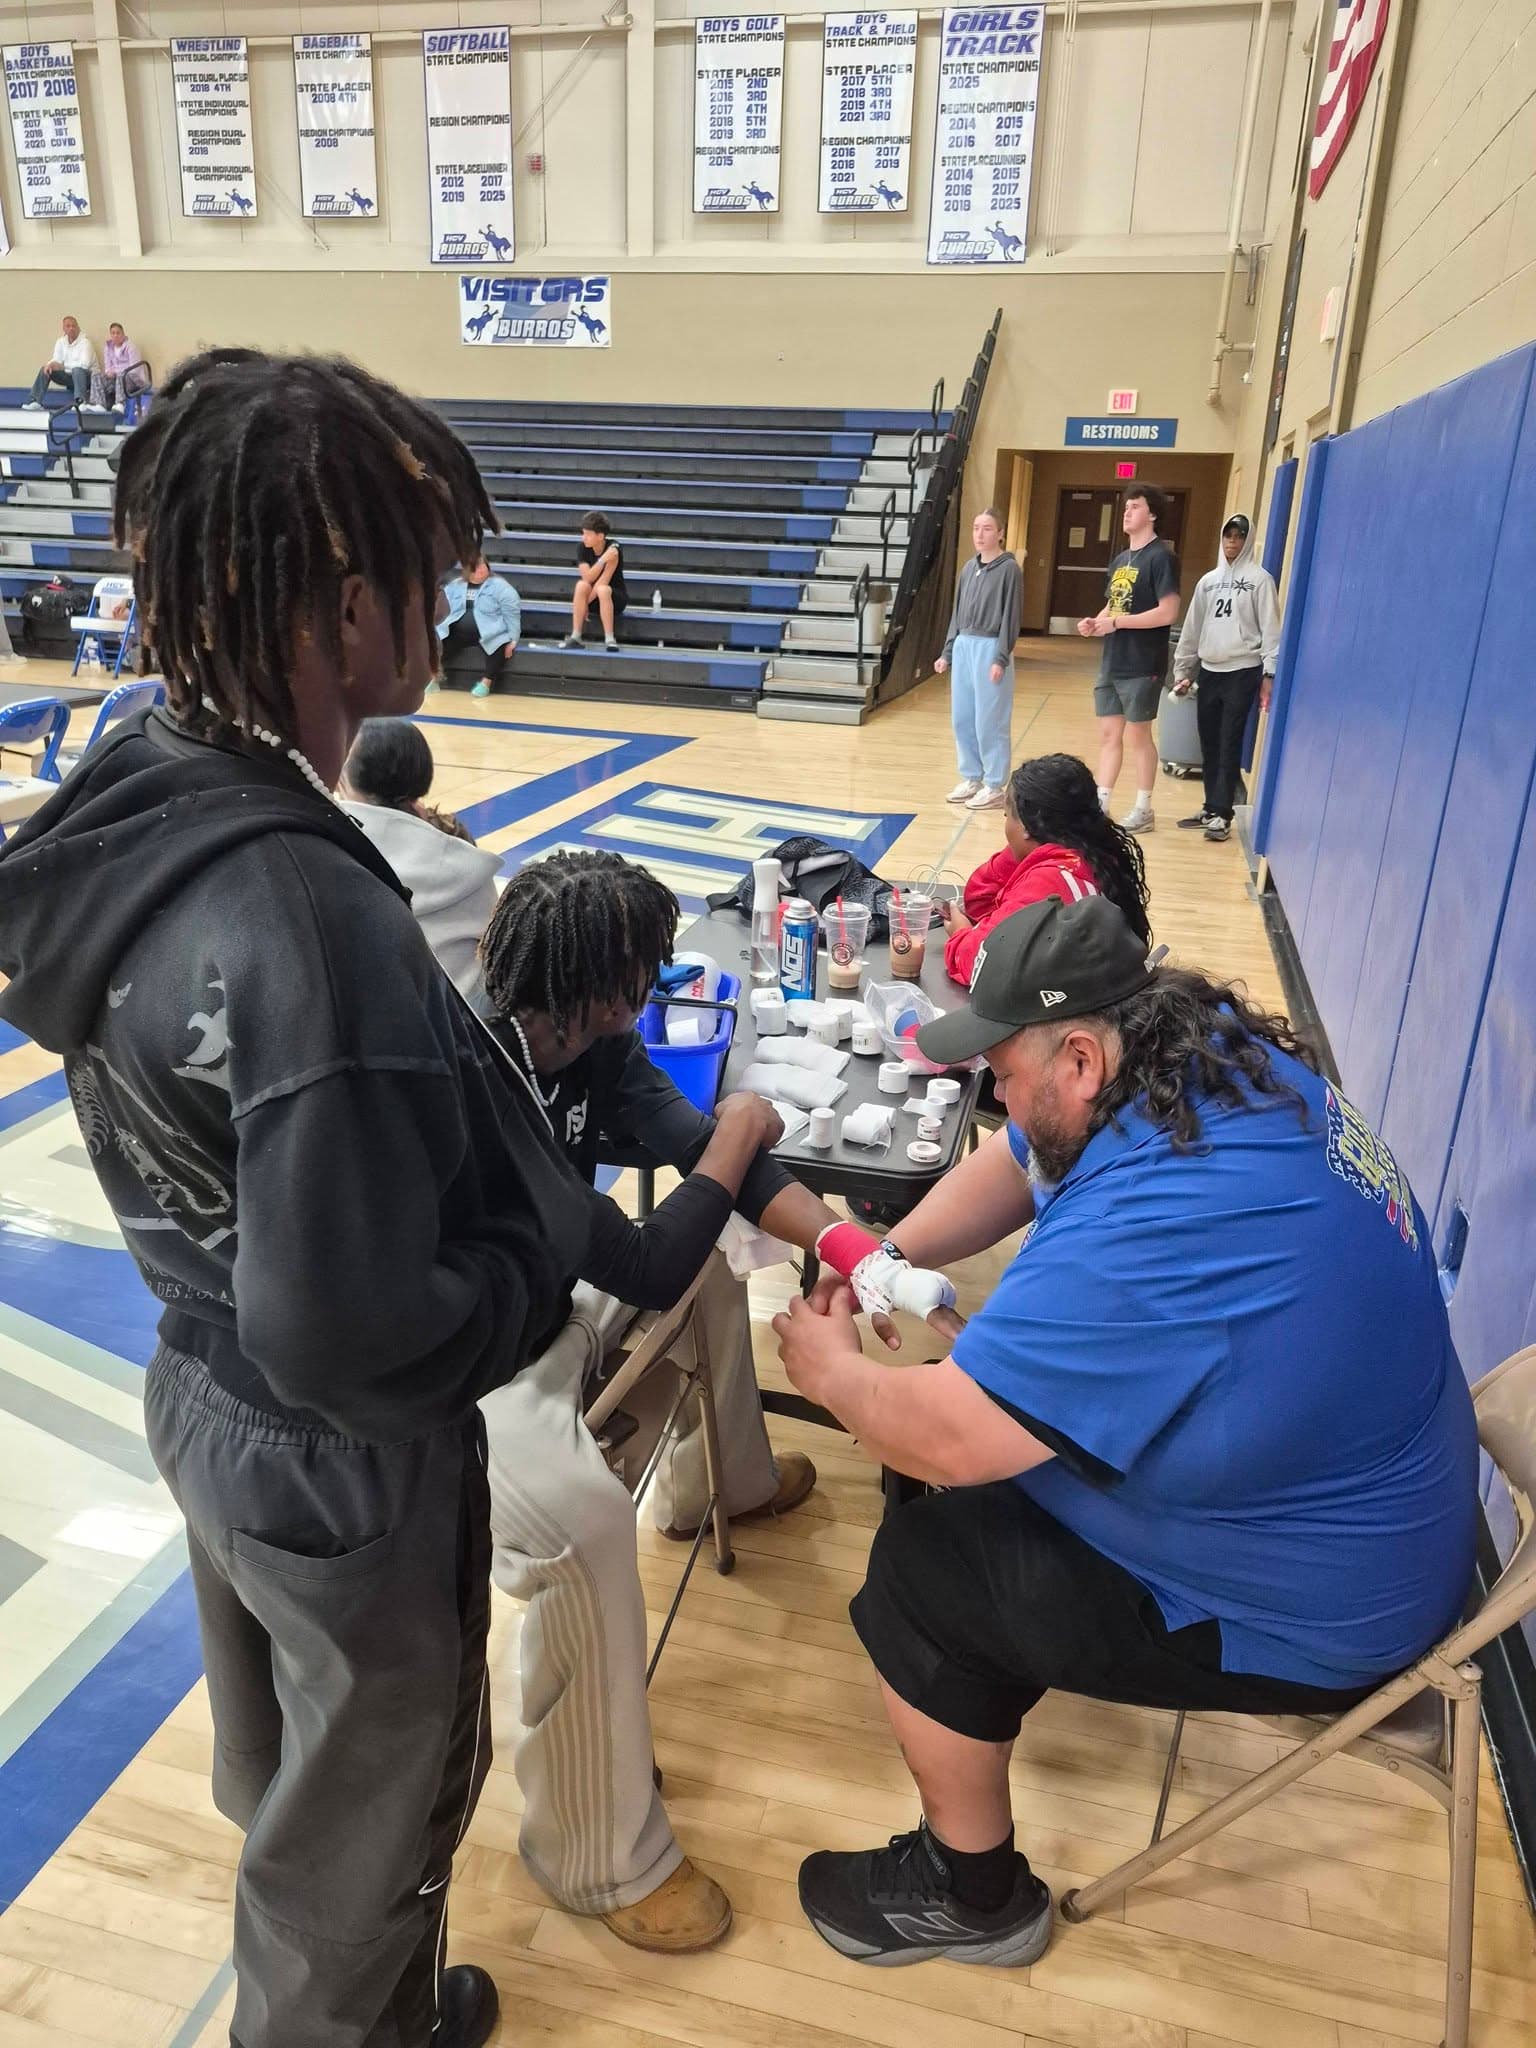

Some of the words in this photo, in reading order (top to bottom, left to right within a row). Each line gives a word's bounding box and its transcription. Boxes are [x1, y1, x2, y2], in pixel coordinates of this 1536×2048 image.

[856, 14, 887, 24] BOYS
[948, 10, 1039, 32] GIRLS
[703, 19, 740, 33] BOYS
[746, 17, 779, 31] GOLF
[827, 25, 863, 37] TRACK
[869, 25, 878, 35] &
[885, 24, 916, 35] FIELD
[302, 36, 362, 49] BASEBALL
[427, 32, 508, 52] SOFTBALL
[697, 34, 727, 44] STATE
[728, 32, 784, 43] CHAMPIONS
[826, 38, 856, 48] STATE
[858, 36, 917, 46] CHAMPIONS
[176, 39, 241, 52] WRESTLING
[945, 33, 1039, 57] TRACK
[21, 45, 49, 57] BOYS
[295, 51, 321, 60] STATE
[322, 49, 371, 59] CHAMPONS
[6, 56, 73, 71] BASKETBALL
[173, 54, 192, 62] STATE
[426, 54, 454, 66] STATE
[456, 51, 509, 65] CHAMPIONS
[697, 69, 733, 79] STATE
[735, 67, 781, 78] PLACER
[825, 65, 863, 75] STATE
[865, 64, 913, 74] PLACER
[942, 62, 975, 75] STATE
[976, 60, 1039, 74] CHAMPIONS
[7, 72, 29, 81] STATE
[30, 69, 74, 78] CHAMPIONS
[175, 73, 198, 82] STATE
[199, 73, 219, 82] DUAL
[219, 73, 248, 82] PLACER
[841, 76, 866, 86] 2017
[871, 75, 892, 85] 5TH
[190, 84, 210, 92] 2018
[214, 84, 232, 92] 4TH
[297, 83, 329, 92] STATE
[331, 82, 371, 92] PLACER
[710, 79, 734, 89] 2015
[747, 78, 768, 88] 2ND
[949, 76, 980, 89] 2025
[9, 81, 38, 99] 2017
[43, 79, 76, 96] 2018
[840, 88, 866, 98] 2018
[870, 87, 892, 97] 3RD
[311, 93, 336, 104] 2008
[338, 93, 357, 102] 4TH
[710, 92, 734, 102] 2016
[747, 91, 767, 101] 3RD
[178, 100, 203, 108] STATE
[710, 104, 733, 115] 2017
[746, 103, 767, 114] 4TH
[840, 100, 865, 110] 2019
[869, 99, 892, 109] 4TH
[940, 102, 976, 114] REGION
[976, 100, 1035, 114] CHAMPIONS
[13, 110, 41, 119] STATE
[43, 107, 78, 117] PLACER
[188, 109, 238, 117] CHAMPIONS
[840, 112, 865, 122] 2021
[869, 111, 891, 121] 3RD
[23, 119, 41, 128] 2017
[53, 118, 67, 126] 1ST
[429, 116, 460, 127] REGION
[461, 114, 510, 126] CHAMPIONS
[710, 117, 733, 127] 2018
[746, 116, 767, 126] 5TH
[949, 118, 976, 130] 2014
[996, 116, 1024, 129] 2015
[187, 130, 220, 138] REGION
[221, 130, 246, 138] DUAL
[300, 129, 328, 137] REGION
[328, 128, 375, 137] CHAMPIONS
[710, 129, 734, 139] 2019
[746, 128, 766, 139] 3RD
[25, 140, 46, 149] 2020
[51, 138, 76, 147] COVID
[192, 138, 241, 146] CHAMPIONS
[314, 138, 338, 148] 2008
[822, 137, 855, 146] REGION
[855, 136, 911, 145] CHAMPIONS
[948, 136, 975, 148] 2016
[995, 134, 1021, 147] 2017
[188, 146, 209, 155] 2018
[695, 147, 727, 155] REGION
[728, 145, 780, 155] CHAMPIONS
[831, 147, 856, 157] 2016
[876, 146, 900, 156] 2017
[708, 156, 733, 166] 2015
[831, 159, 855, 169] 2018
[874, 159, 899, 168] 2019
[941, 156, 967, 167] STATE
[968, 154, 1027, 166] PLACEWINNER
[27, 165, 47, 175] 2017
[212, 166, 253, 174] INDIVIDUAL
[435, 165, 458, 175] STATE
[945, 169, 973, 181] 2014
[992, 167, 1020, 180] 2015
[27, 176, 51, 186] 2020
[440, 176, 464, 188] 2012
[480, 175, 503, 187] 2017
[831, 172, 855, 182] 2021
[945, 184, 972, 197] 2016
[992, 183, 1019, 196] 2017
[441, 191, 465, 202] 2019
[480, 190, 506, 202] 2025
[703, 195, 752, 206] BURROS
[829, 194, 880, 205] BURROS
[944, 200, 971, 211] 2018
[990, 198, 1021, 210] 2025
[439, 242, 489, 255] BURROS
[461, 276, 608, 303] VISITORS
[497, 318, 576, 339] BURROS
[1113, 393, 1133, 409] EXIT
[1082, 424, 1160, 440] RESTROOMS
[1215, 599, 1232, 618] 24
[781, 926, 803, 992] NOS
